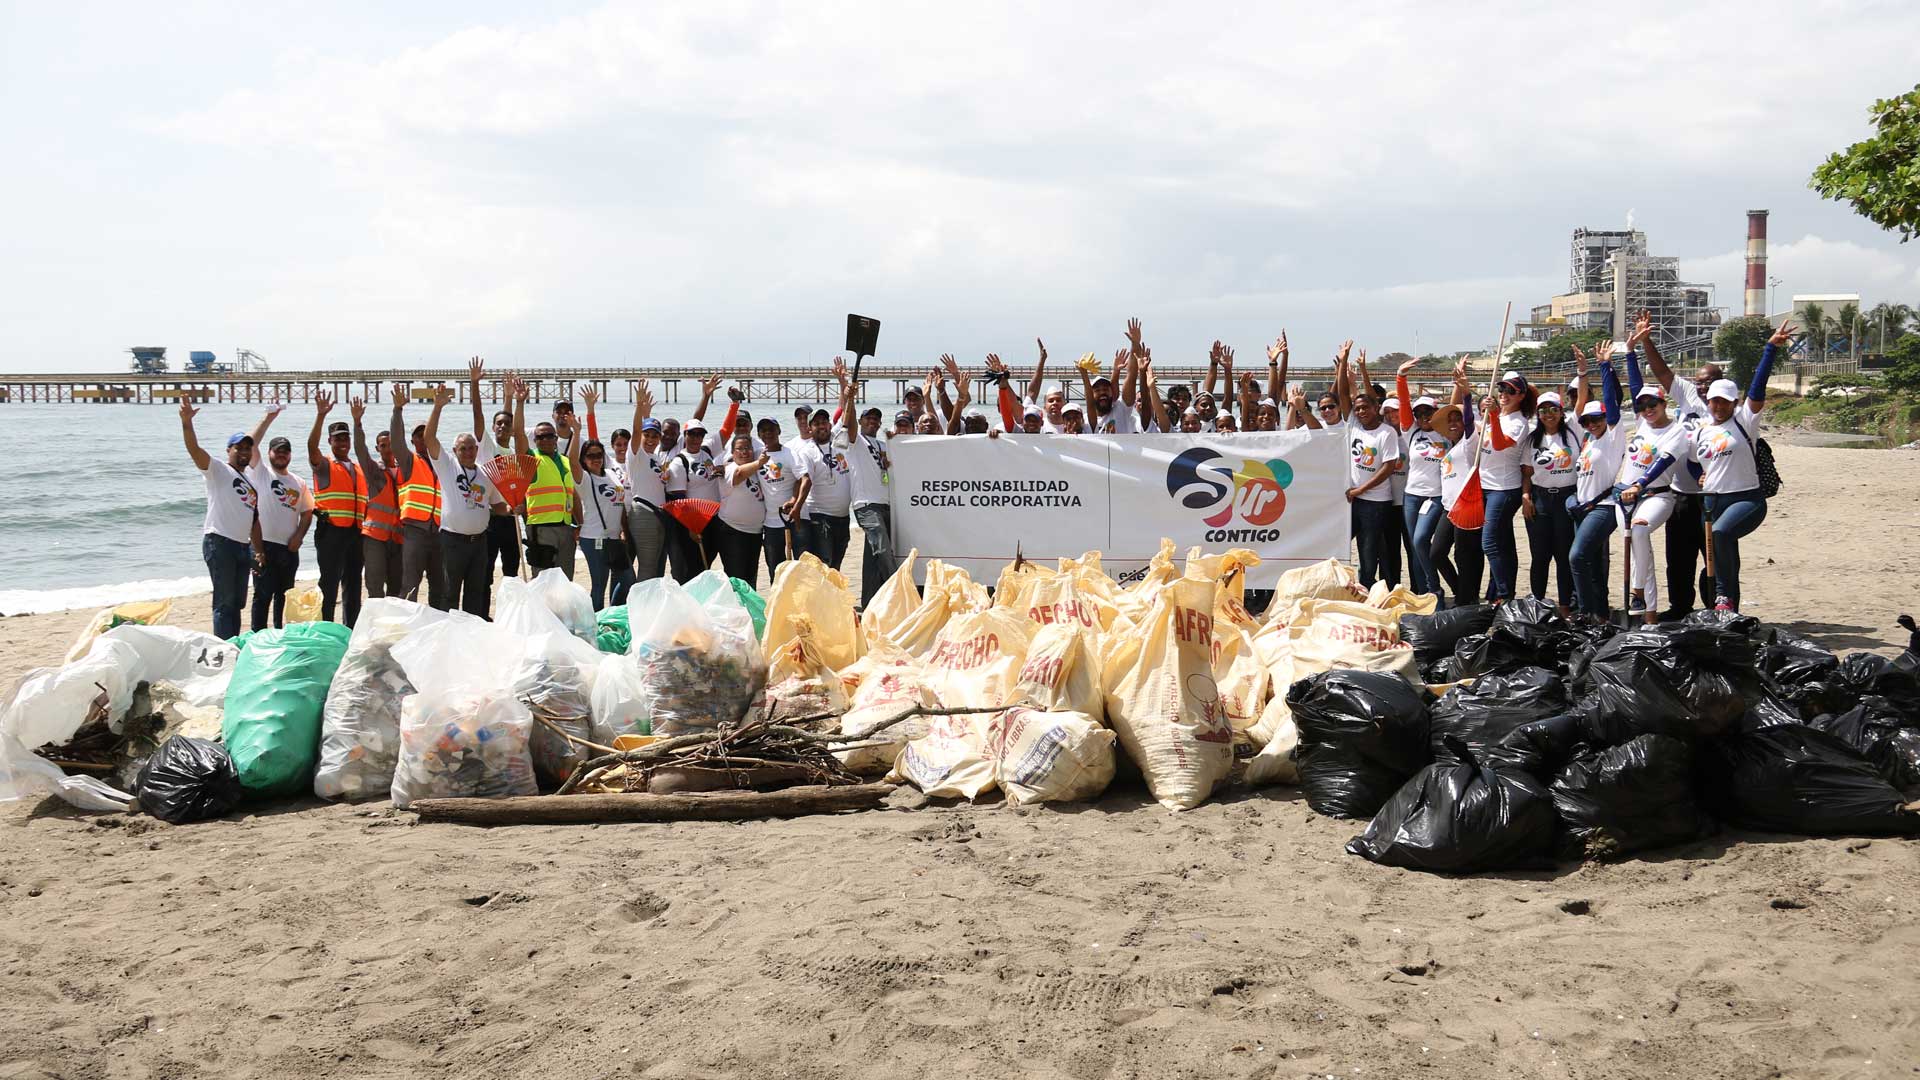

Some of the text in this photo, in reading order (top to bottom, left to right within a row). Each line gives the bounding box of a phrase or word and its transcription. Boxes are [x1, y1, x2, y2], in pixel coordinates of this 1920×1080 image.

[921, 480, 1069, 492] RESPONSABILIDAD
[1168, 453, 1282, 524] Sur
[910, 495, 1082, 507] SOCIAL CORPORATIVA
[1205, 528, 1281, 543] CONTIGO
[1010, 716, 1031, 748] LIBRAS
